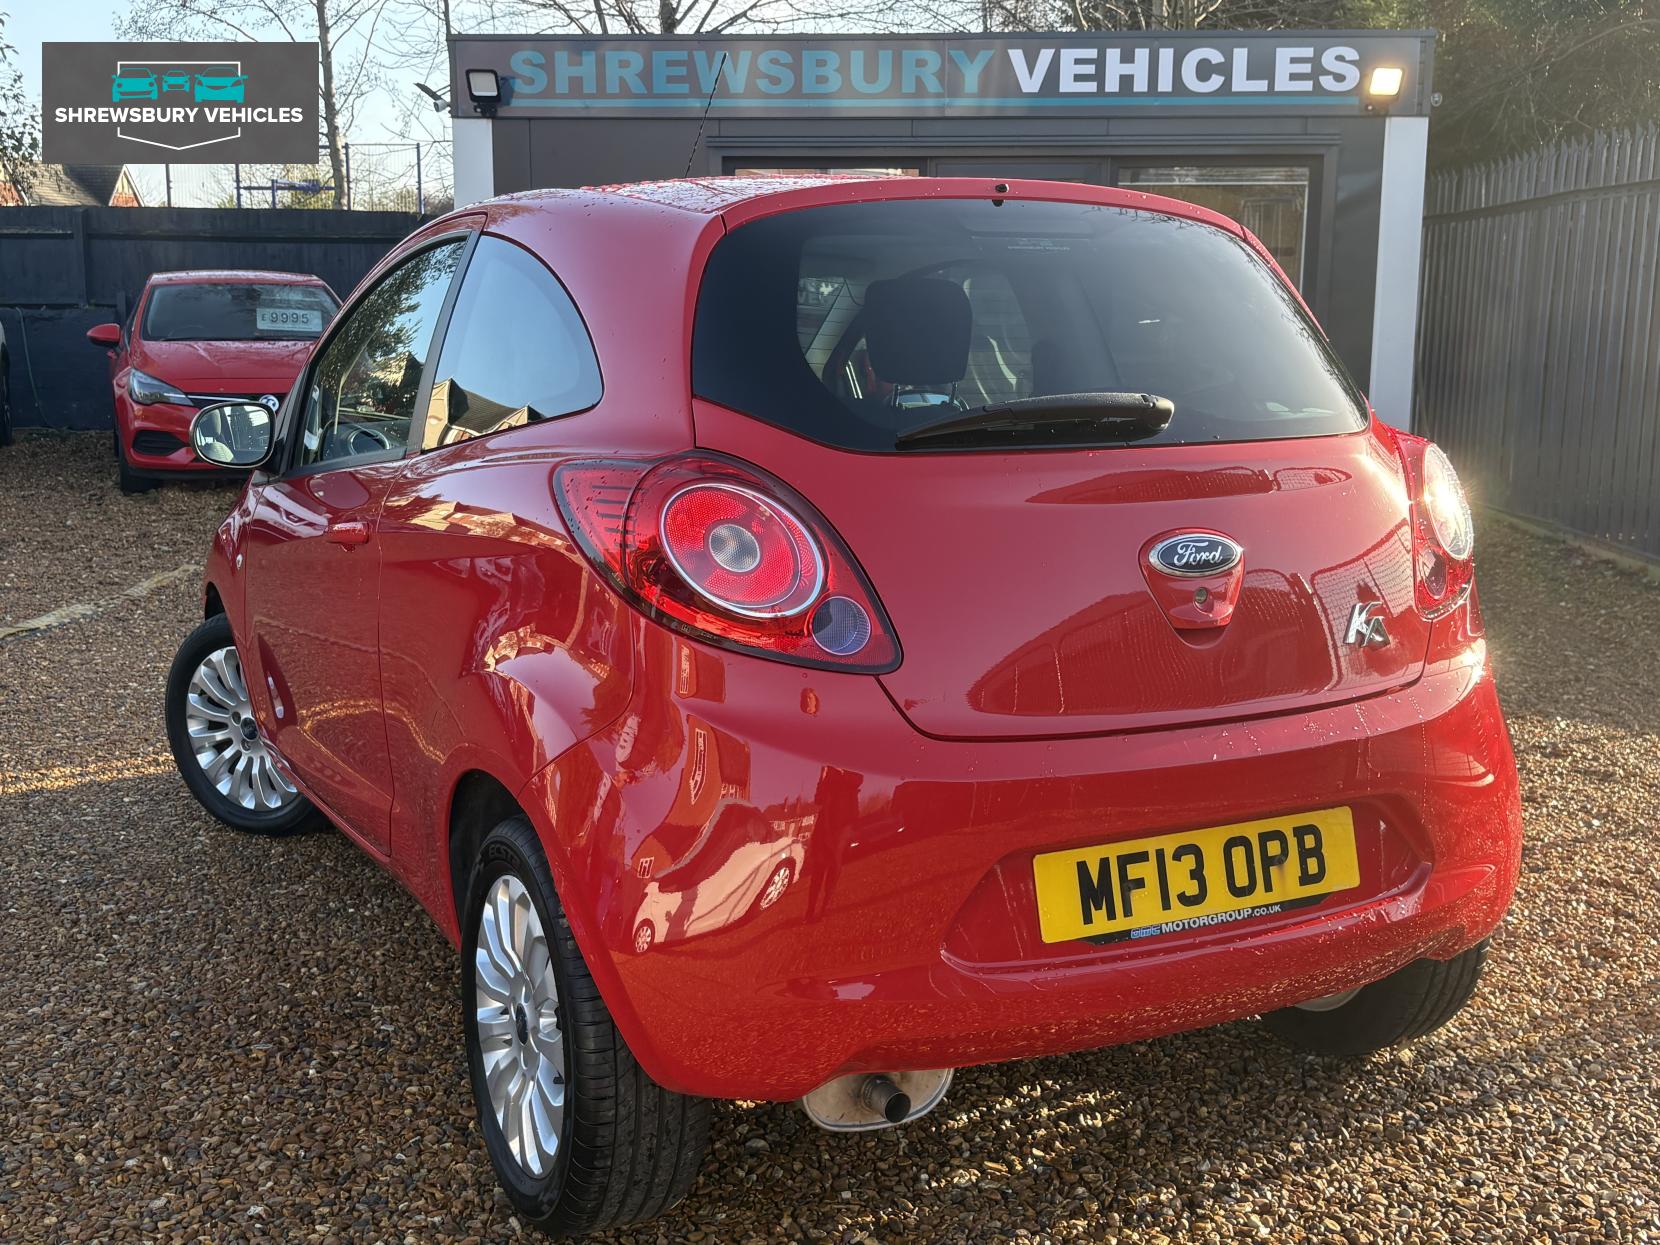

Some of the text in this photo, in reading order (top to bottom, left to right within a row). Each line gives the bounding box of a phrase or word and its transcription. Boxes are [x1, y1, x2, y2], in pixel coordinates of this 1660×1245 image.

[509, 46, 1361, 95] SHREWSBURY VEHICLES
[1173, 541, 1223, 567] Ford
[1076, 823, 1327, 926] MF13 OPB
